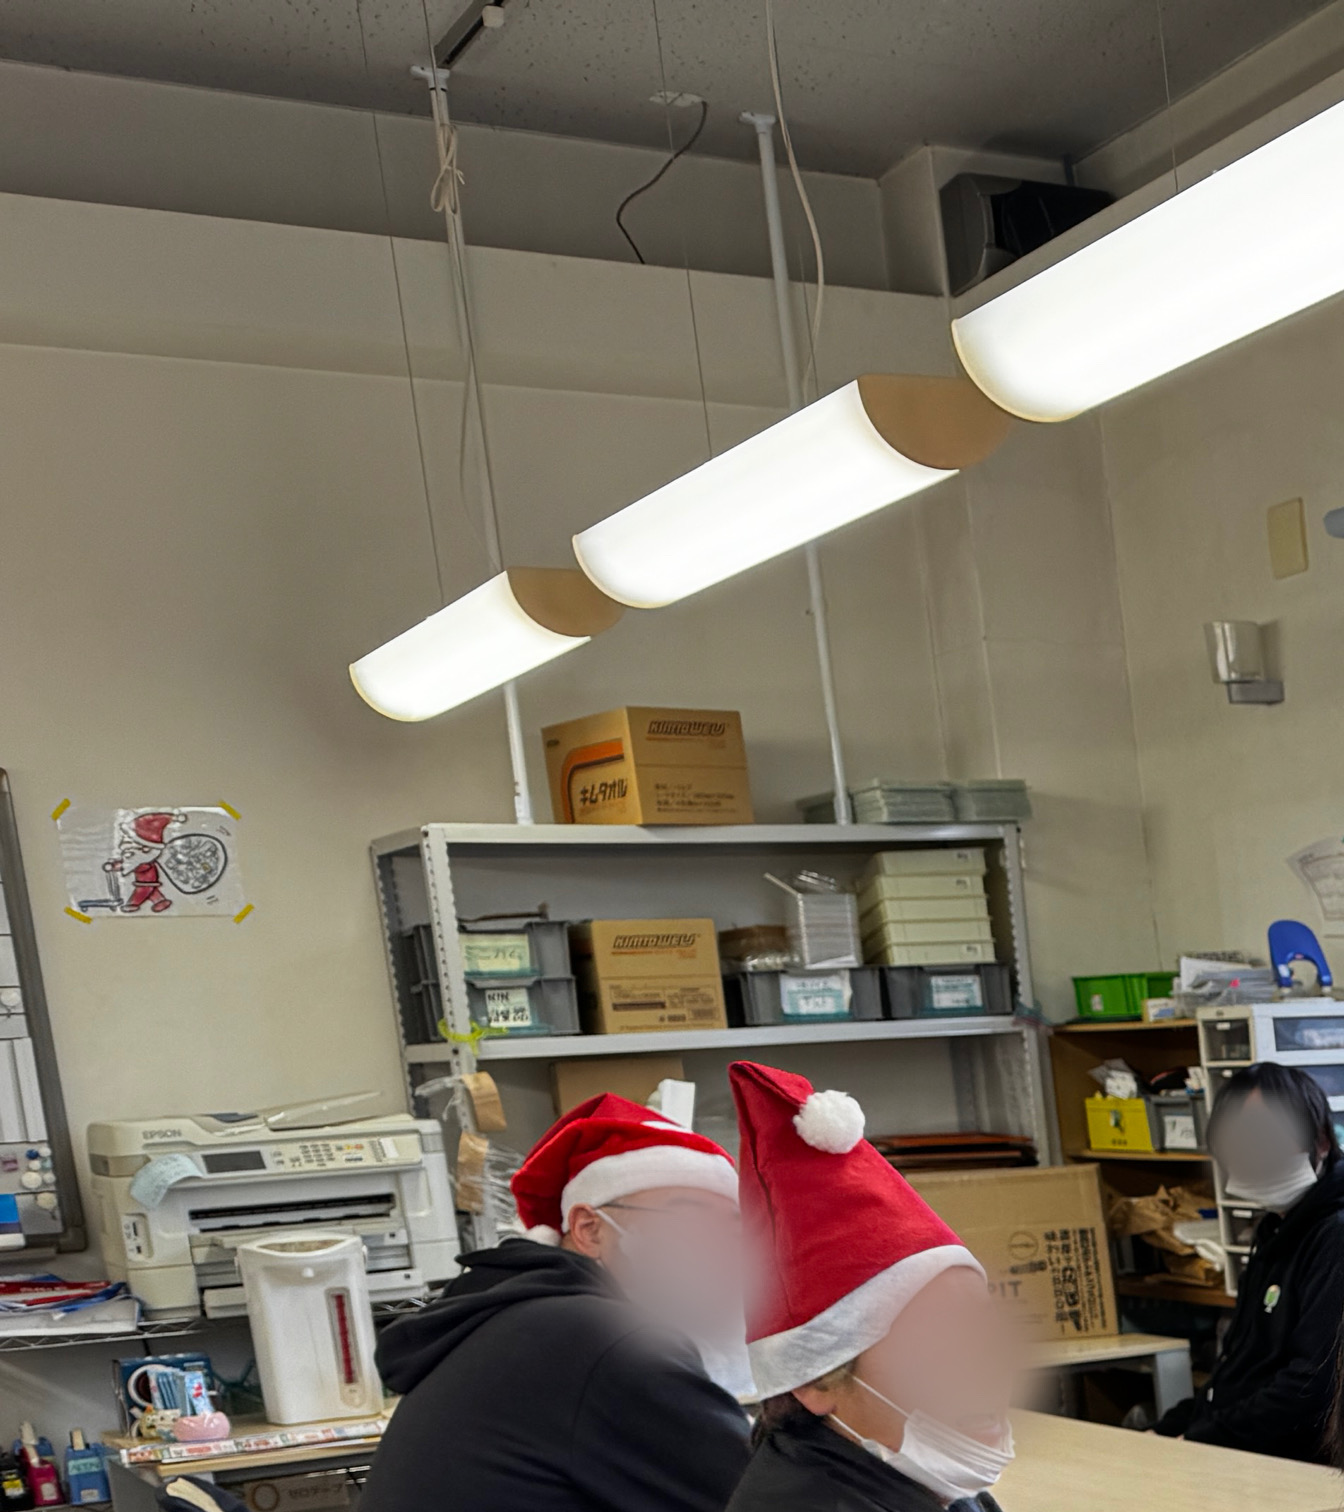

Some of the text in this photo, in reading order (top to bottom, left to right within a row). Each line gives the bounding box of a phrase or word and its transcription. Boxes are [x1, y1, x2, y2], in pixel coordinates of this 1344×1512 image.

[580, 779, 628, 805] キムタオル
[142, 1128, 182, 1141] EPSON
